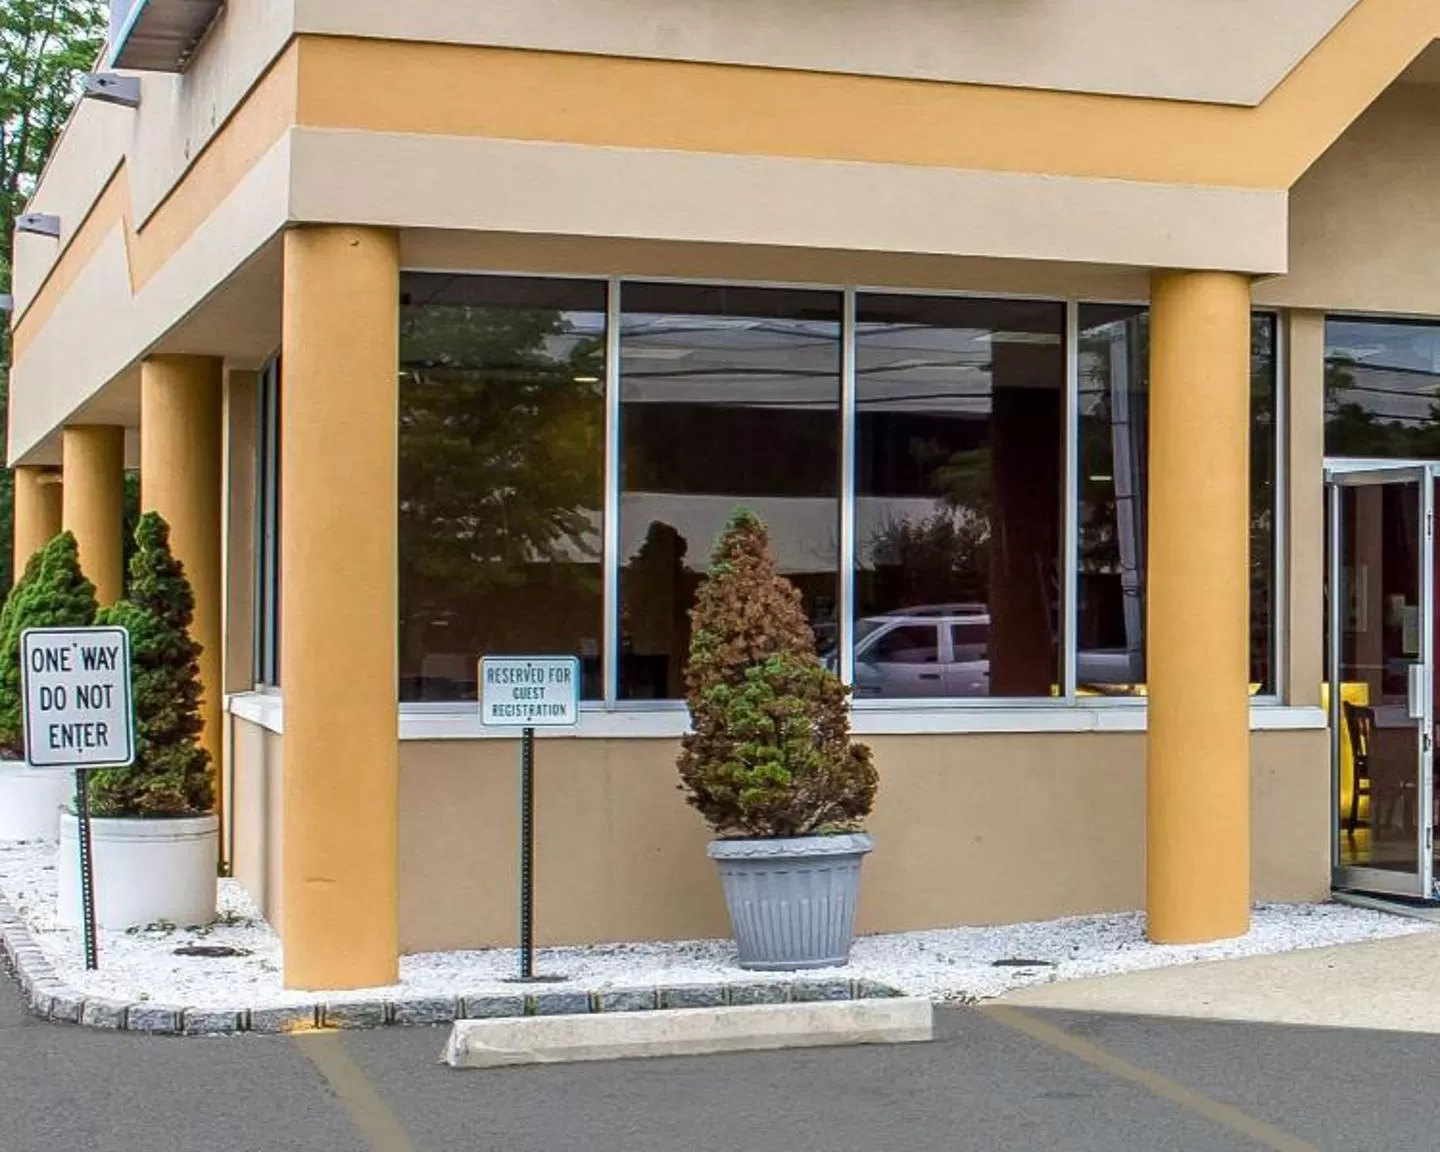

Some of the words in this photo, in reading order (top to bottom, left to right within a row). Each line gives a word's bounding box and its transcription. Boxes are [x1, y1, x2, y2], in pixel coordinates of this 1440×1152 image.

[32, 647, 72, 673] ONE
[82, 646, 119, 671] WAY
[487, 668, 544, 684] RESERVED
[549, 668, 571, 684] FOR
[40, 686, 66, 711] DO
[76, 685, 113, 709] NOT
[512, 687, 545, 700] GUEST
[492, 704, 567, 717] REGISTRATION
[49, 723, 108, 749] ENTER
